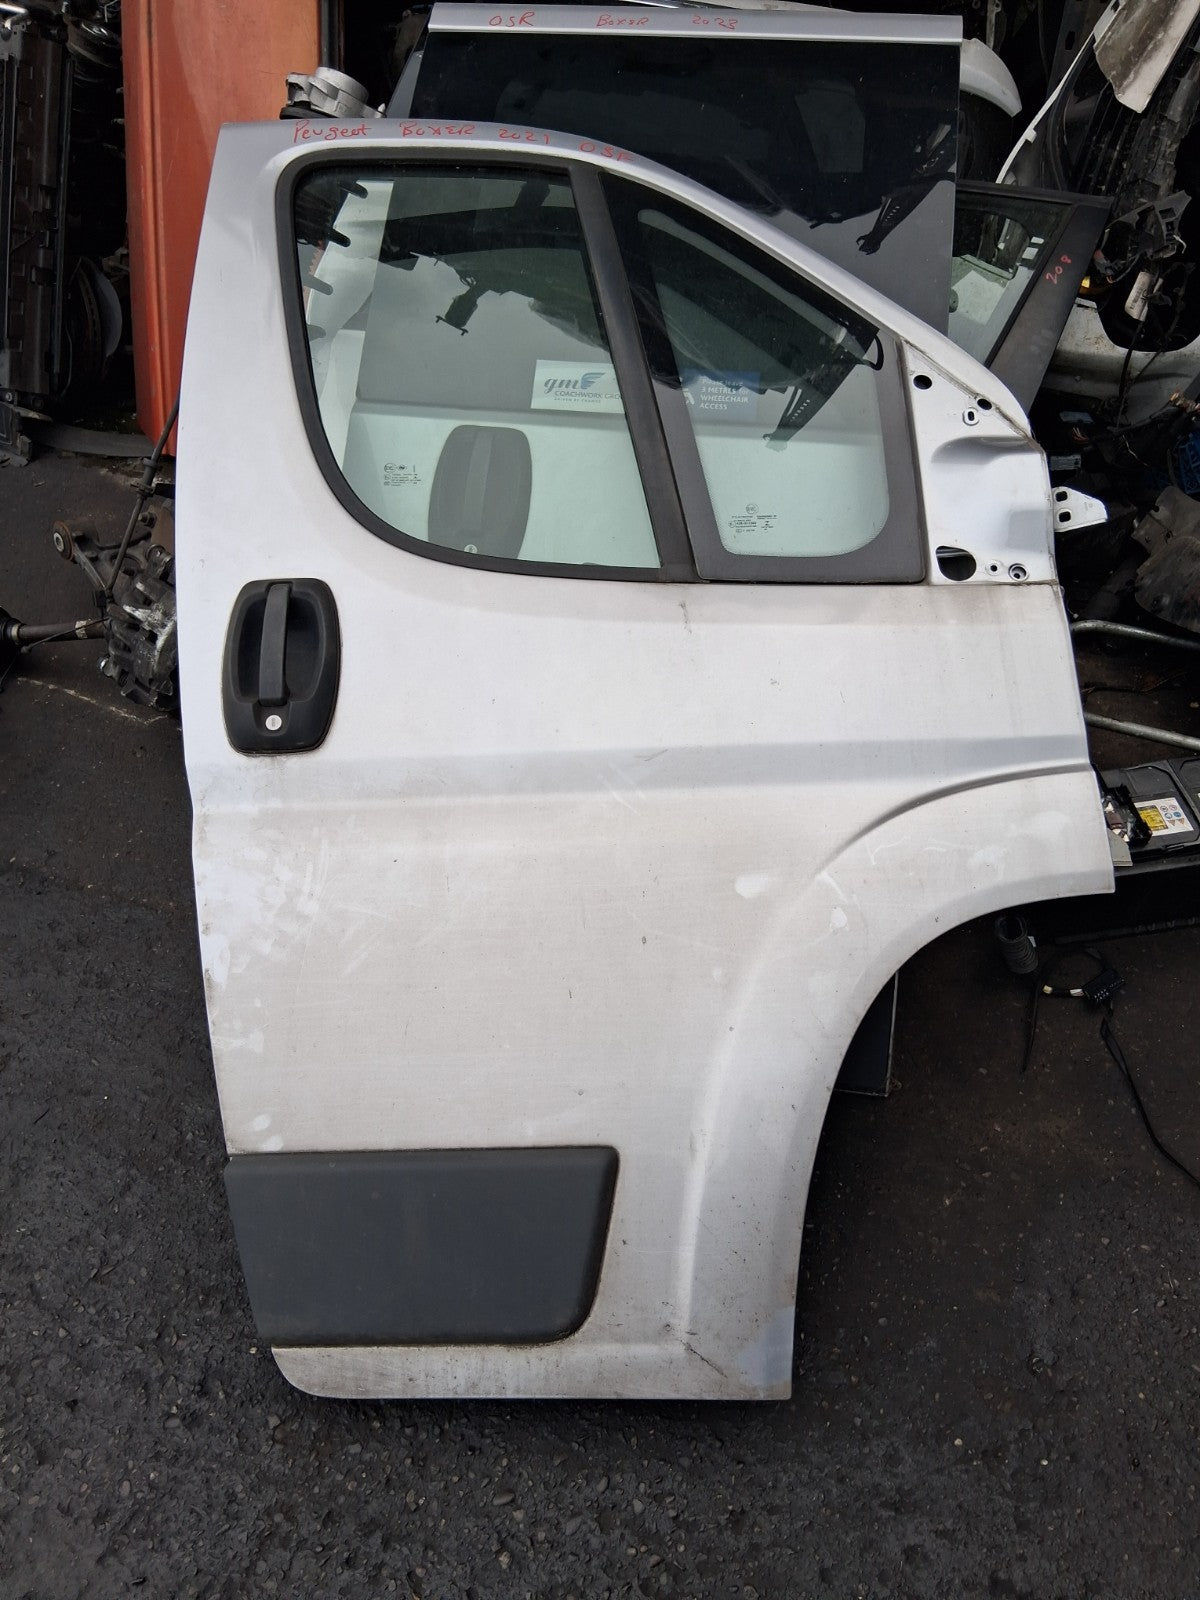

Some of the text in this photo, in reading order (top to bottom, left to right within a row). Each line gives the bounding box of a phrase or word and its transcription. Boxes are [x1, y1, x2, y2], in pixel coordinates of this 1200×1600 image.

[489, 11, 535, 28] OSR
[692, 15, 739, 30] 2023
[499, 127, 550, 145] 2021
[579, 140, 635, 162] OSF
[1045, 254, 1072, 285] 208
[554, 390, 603, 399] COACHWORK
[708, 387, 737, 395] METRES
[700, 394, 750, 404] WHEELCHAIR
[700, 403, 728, 411] ACCESS
